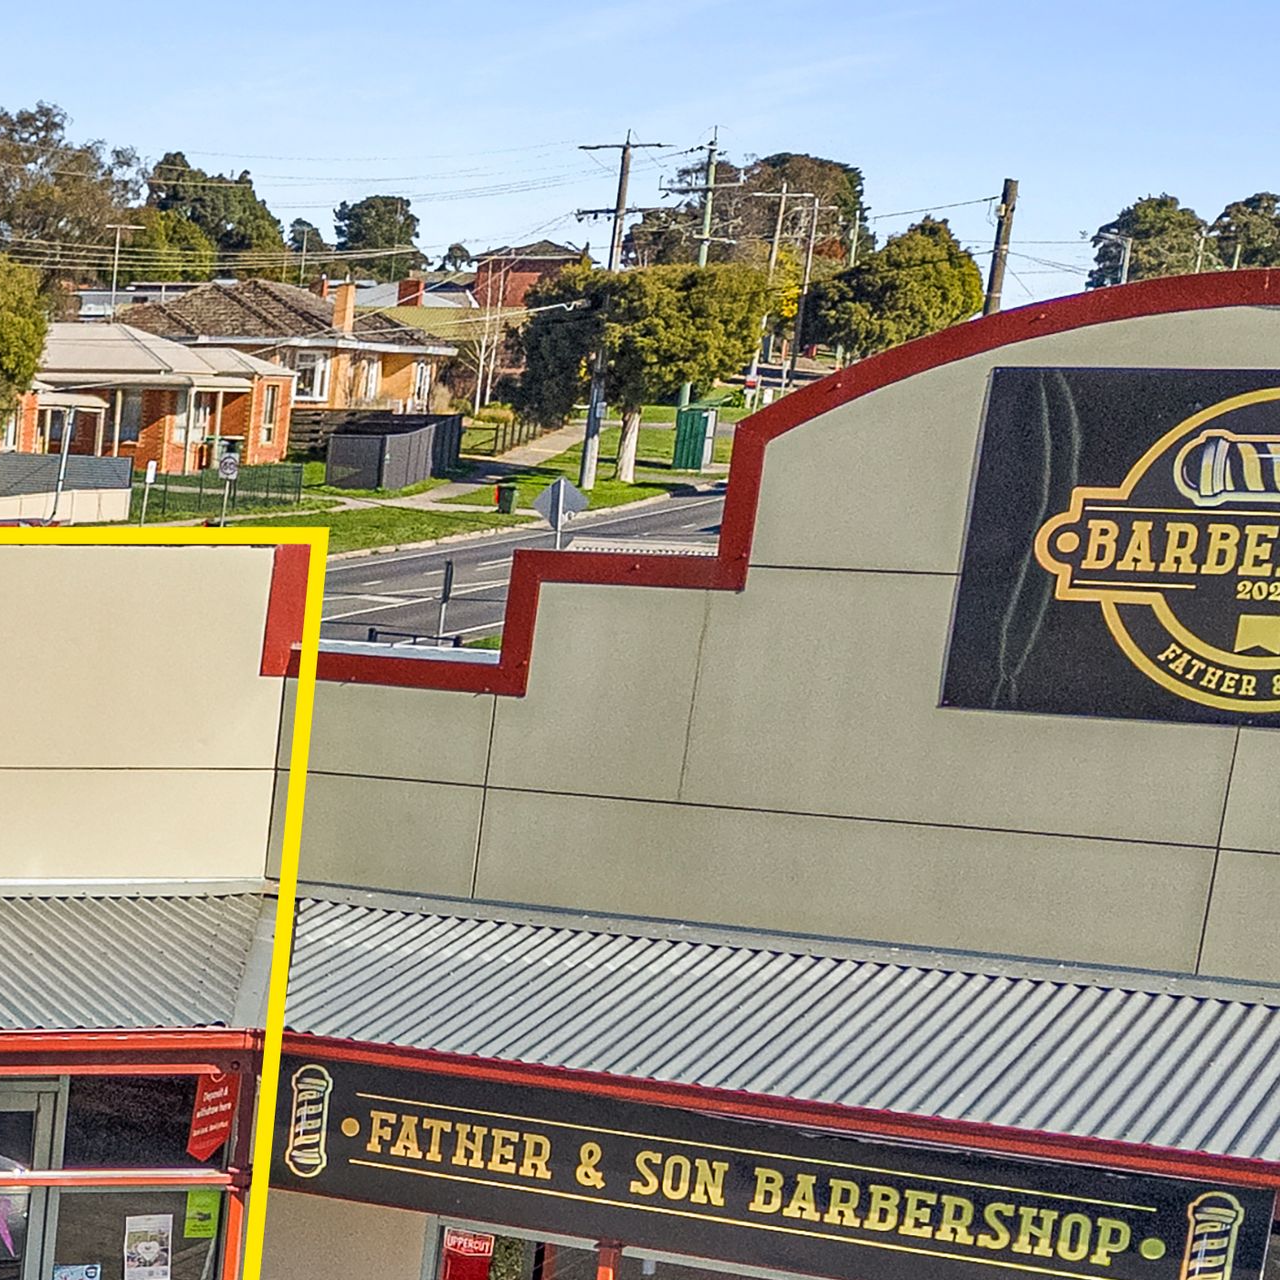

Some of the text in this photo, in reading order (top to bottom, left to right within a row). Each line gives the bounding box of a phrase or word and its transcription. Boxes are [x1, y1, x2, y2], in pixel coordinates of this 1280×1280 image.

[1081, 519, 1280, 578] BARBE
[1157, 642, 1257, 697] FATHER
[366, 1110, 1132, 1267] FATHER & SON BARBERSHOP
[446, 1234, 491, 1253] UPPERCUT
